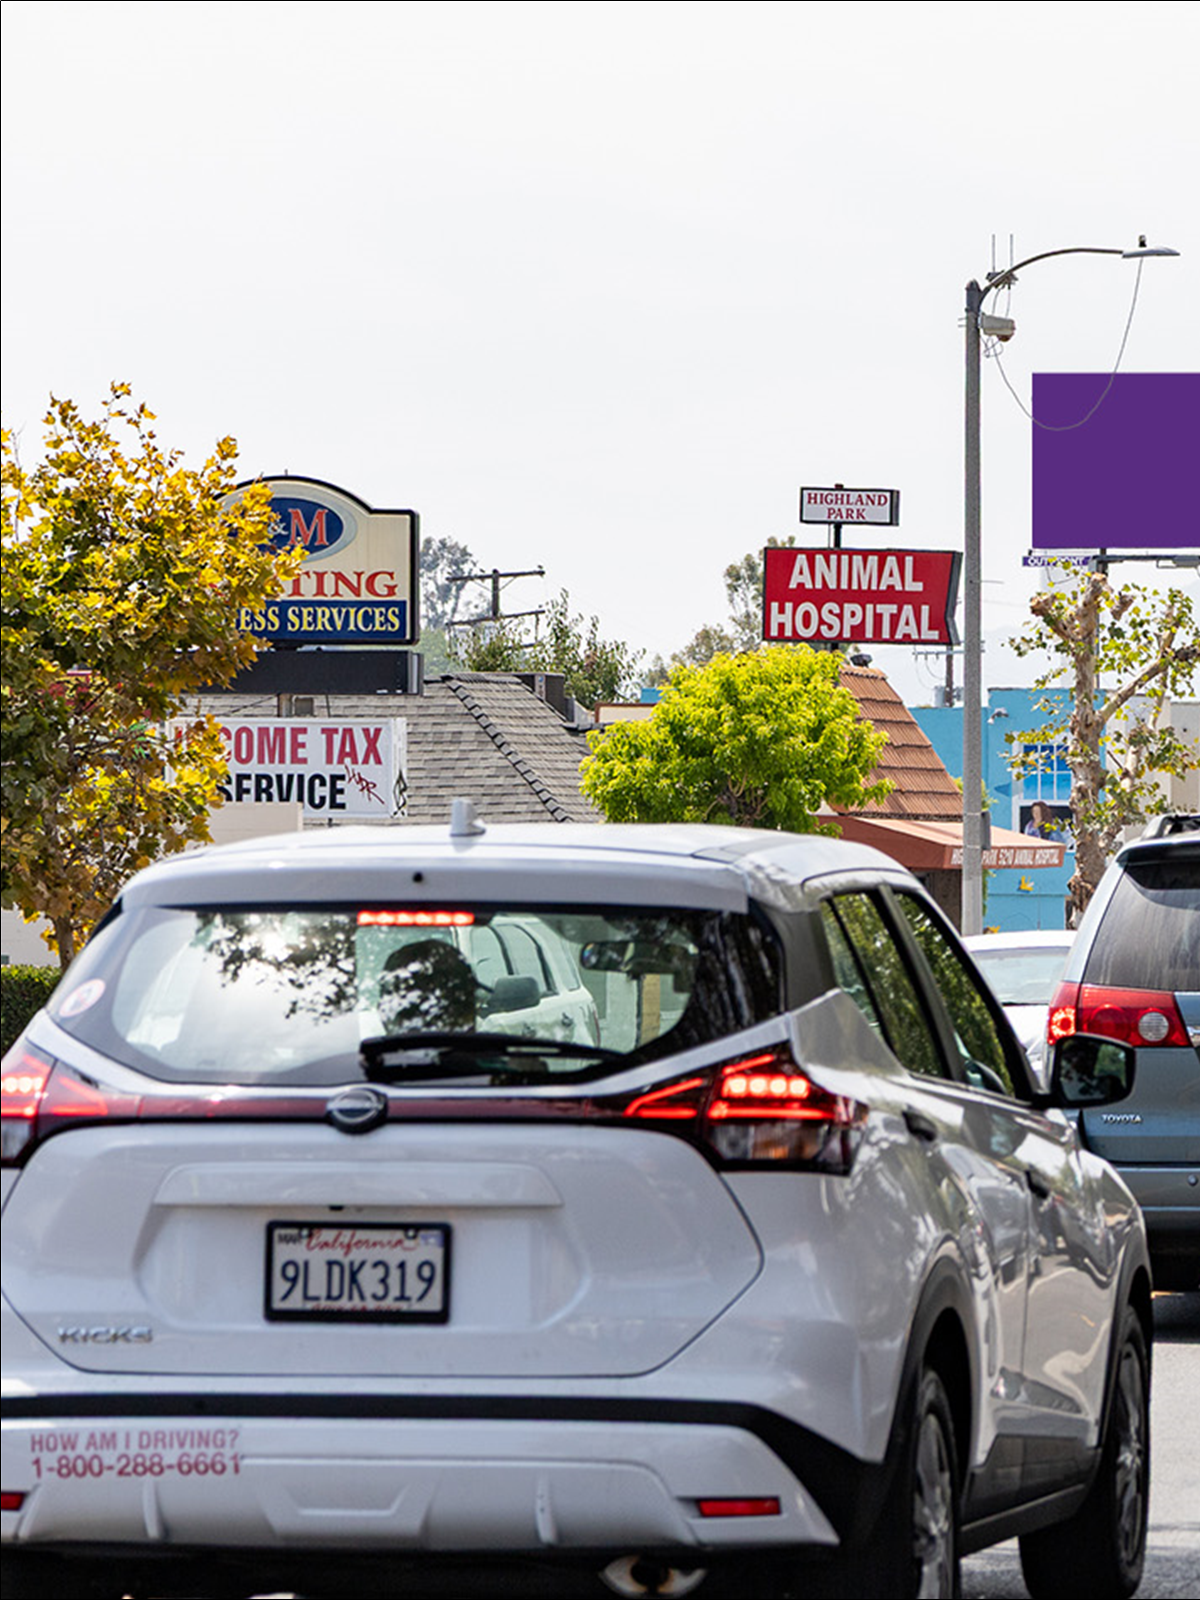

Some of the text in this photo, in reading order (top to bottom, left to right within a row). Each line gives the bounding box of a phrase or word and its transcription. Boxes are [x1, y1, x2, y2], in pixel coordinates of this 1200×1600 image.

[806, 492, 889, 507] HIGHLAND
[826, 507, 867, 520] PARK
[788, 553, 924, 592] ANIMAL
[286, 605, 400, 632] SERVICES
[769, 601, 940, 640] HOSPITAL
[320, 727, 383, 766] TAX
[1101, 1113, 1142, 1124] TOYOTA
[305, 1228, 418, 1258] California
[279, 1258, 437, 1303] 9LDK319
[57, 1326, 154, 1344] KICKS
[30, 1429, 241, 1453] HOW AM I DRIVING?
[31, 1452, 241, 1479] 1-800-288-6661
